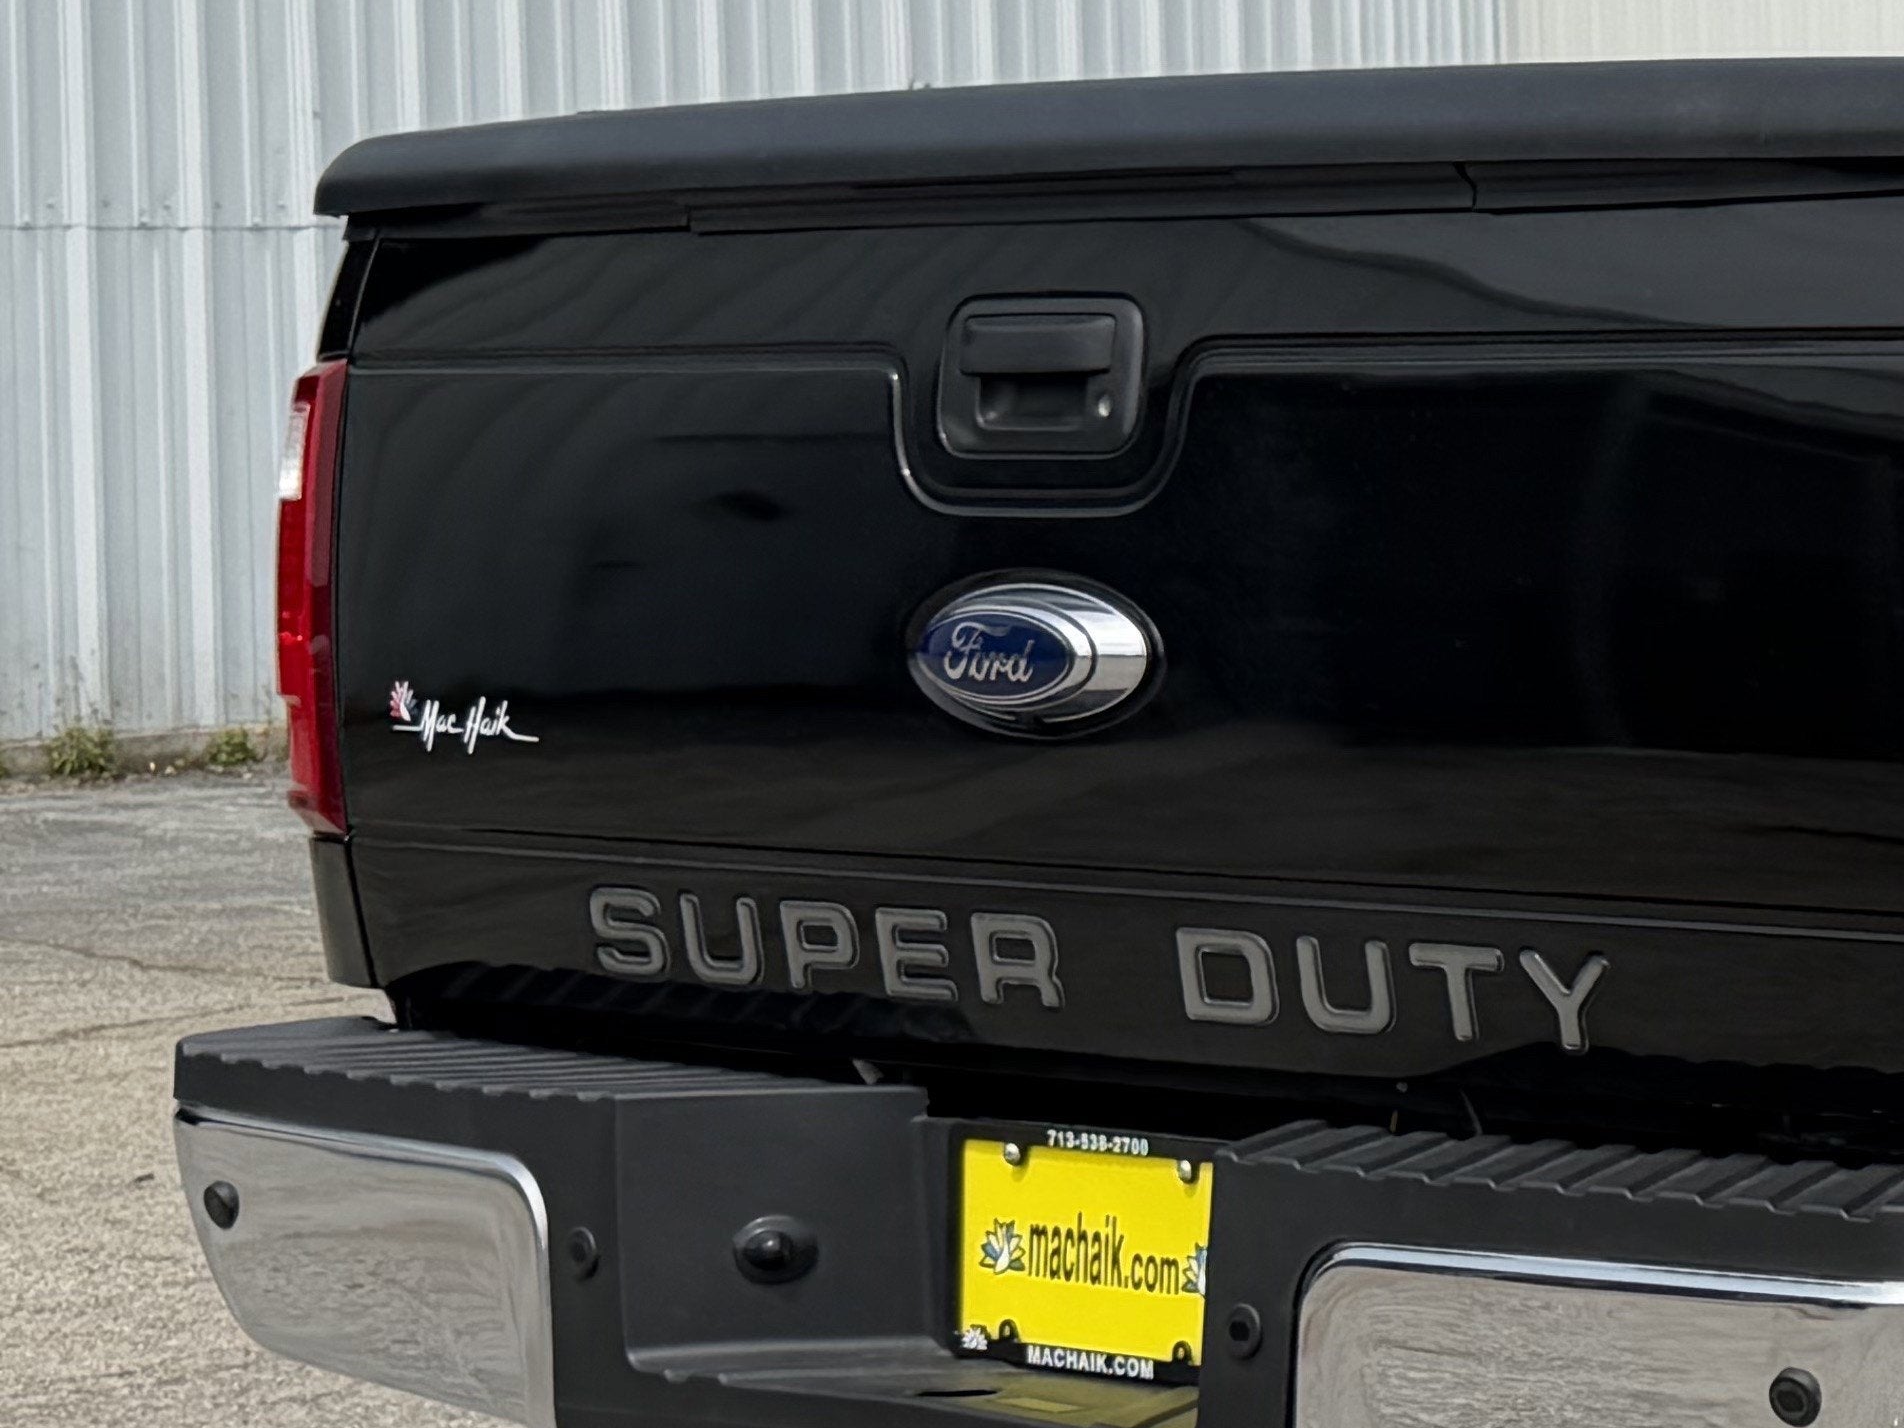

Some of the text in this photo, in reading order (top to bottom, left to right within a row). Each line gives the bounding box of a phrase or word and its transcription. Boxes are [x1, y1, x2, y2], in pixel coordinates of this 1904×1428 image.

[943, 622, 1035, 682] Ford
[393, 695, 540, 755] Mac Haik
[589, 885, 1611, 1053] SUPER DUTY
[1027, 1212, 1181, 1296] machaik.com
[1027, 1345, 1154, 1380] MACHAIK.COM
